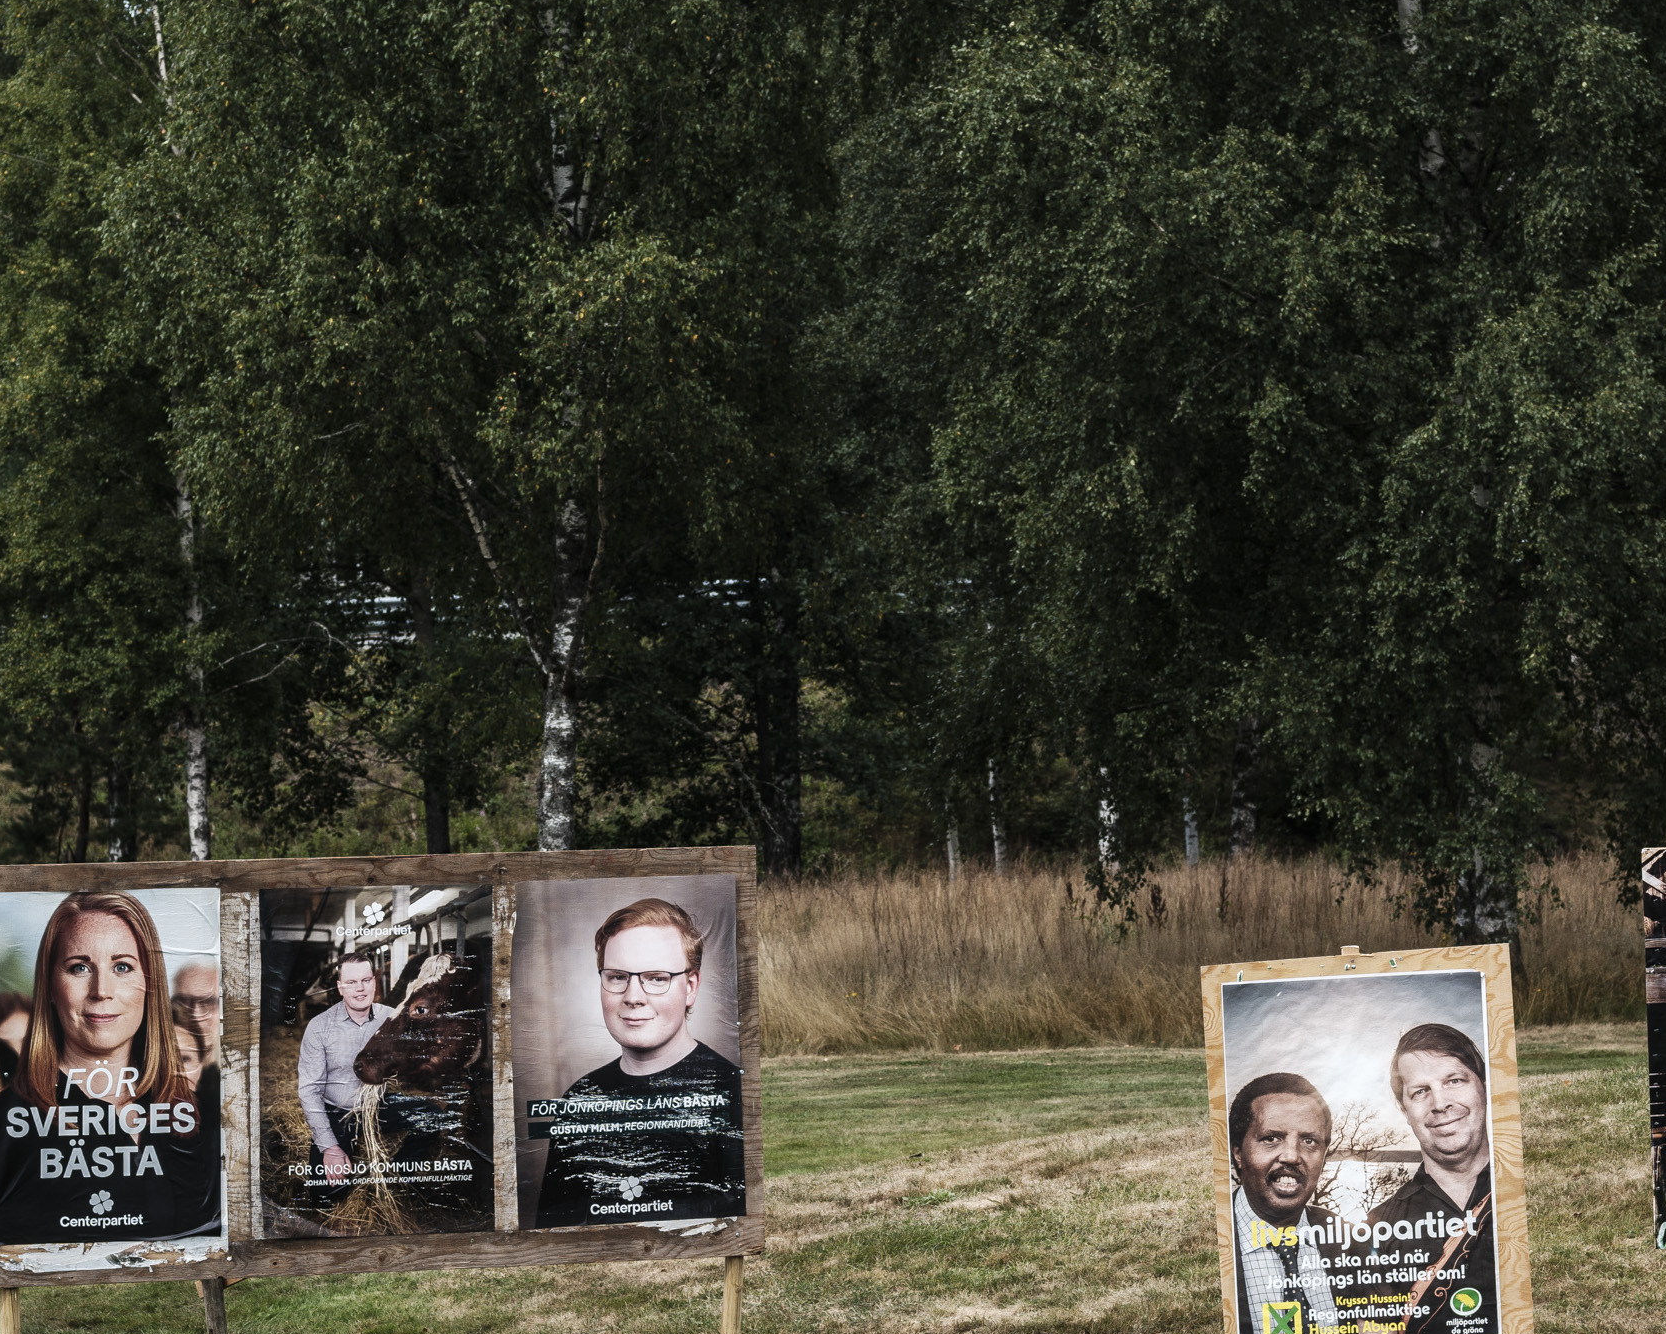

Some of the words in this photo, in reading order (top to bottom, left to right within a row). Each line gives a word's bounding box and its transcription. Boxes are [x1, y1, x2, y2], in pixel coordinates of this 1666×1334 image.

[335, 924, 412, 938] Centerpartiet
[63, 1060, 140, 1099] FÖR
[531, 1100, 557, 1116] FÖR
[646, 1095, 681, 1110] LÄNS
[683, 1093, 726, 1107] BÄSTA
[6, 1102, 196, 1139] SVERIGES
[549, 1124, 589, 1135] GUSTAV
[40, 1138, 164, 1179] BÄSTA
[288, 1162, 313, 1176] FÖR
[315, 1160, 367, 1176] GNOSJÖ
[369, 1160, 431, 1173] KOMMUNS
[434, 1157, 473, 1171] BÄSTA
[303, 1179, 328, 1187] JOHAN
[590, 1199, 674, 1215] Centerpartiet
[59, 1214, 144, 1229] Centerpartiet
[1301, 1254, 1331, 1269] Alla
[1334, 1253, 1362, 1268] ska
[1365, 1250, 1400, 1266] med
[1404, 1249, 1430, 1264] när
[1266, 1272, 1354, 1290] Jönköpings
[1357, 1270, 1382, 1285] län
[1385, 1267, 1433, 1283] ställer
[1436, 1264, 1466, 1280] om!
[1336, 1295, 1368, 1307] Kryssa
[1370, 1292, 1411, 1304] Hussein!
[1308, 1304, 1431, 1323] Regionfullmäktige
[1362, 1320, 1406, 1334] Abyan
[1446, 1317, 1489, 1328] miljöpartiet
[1451, 1327, 1461, 1334] de
